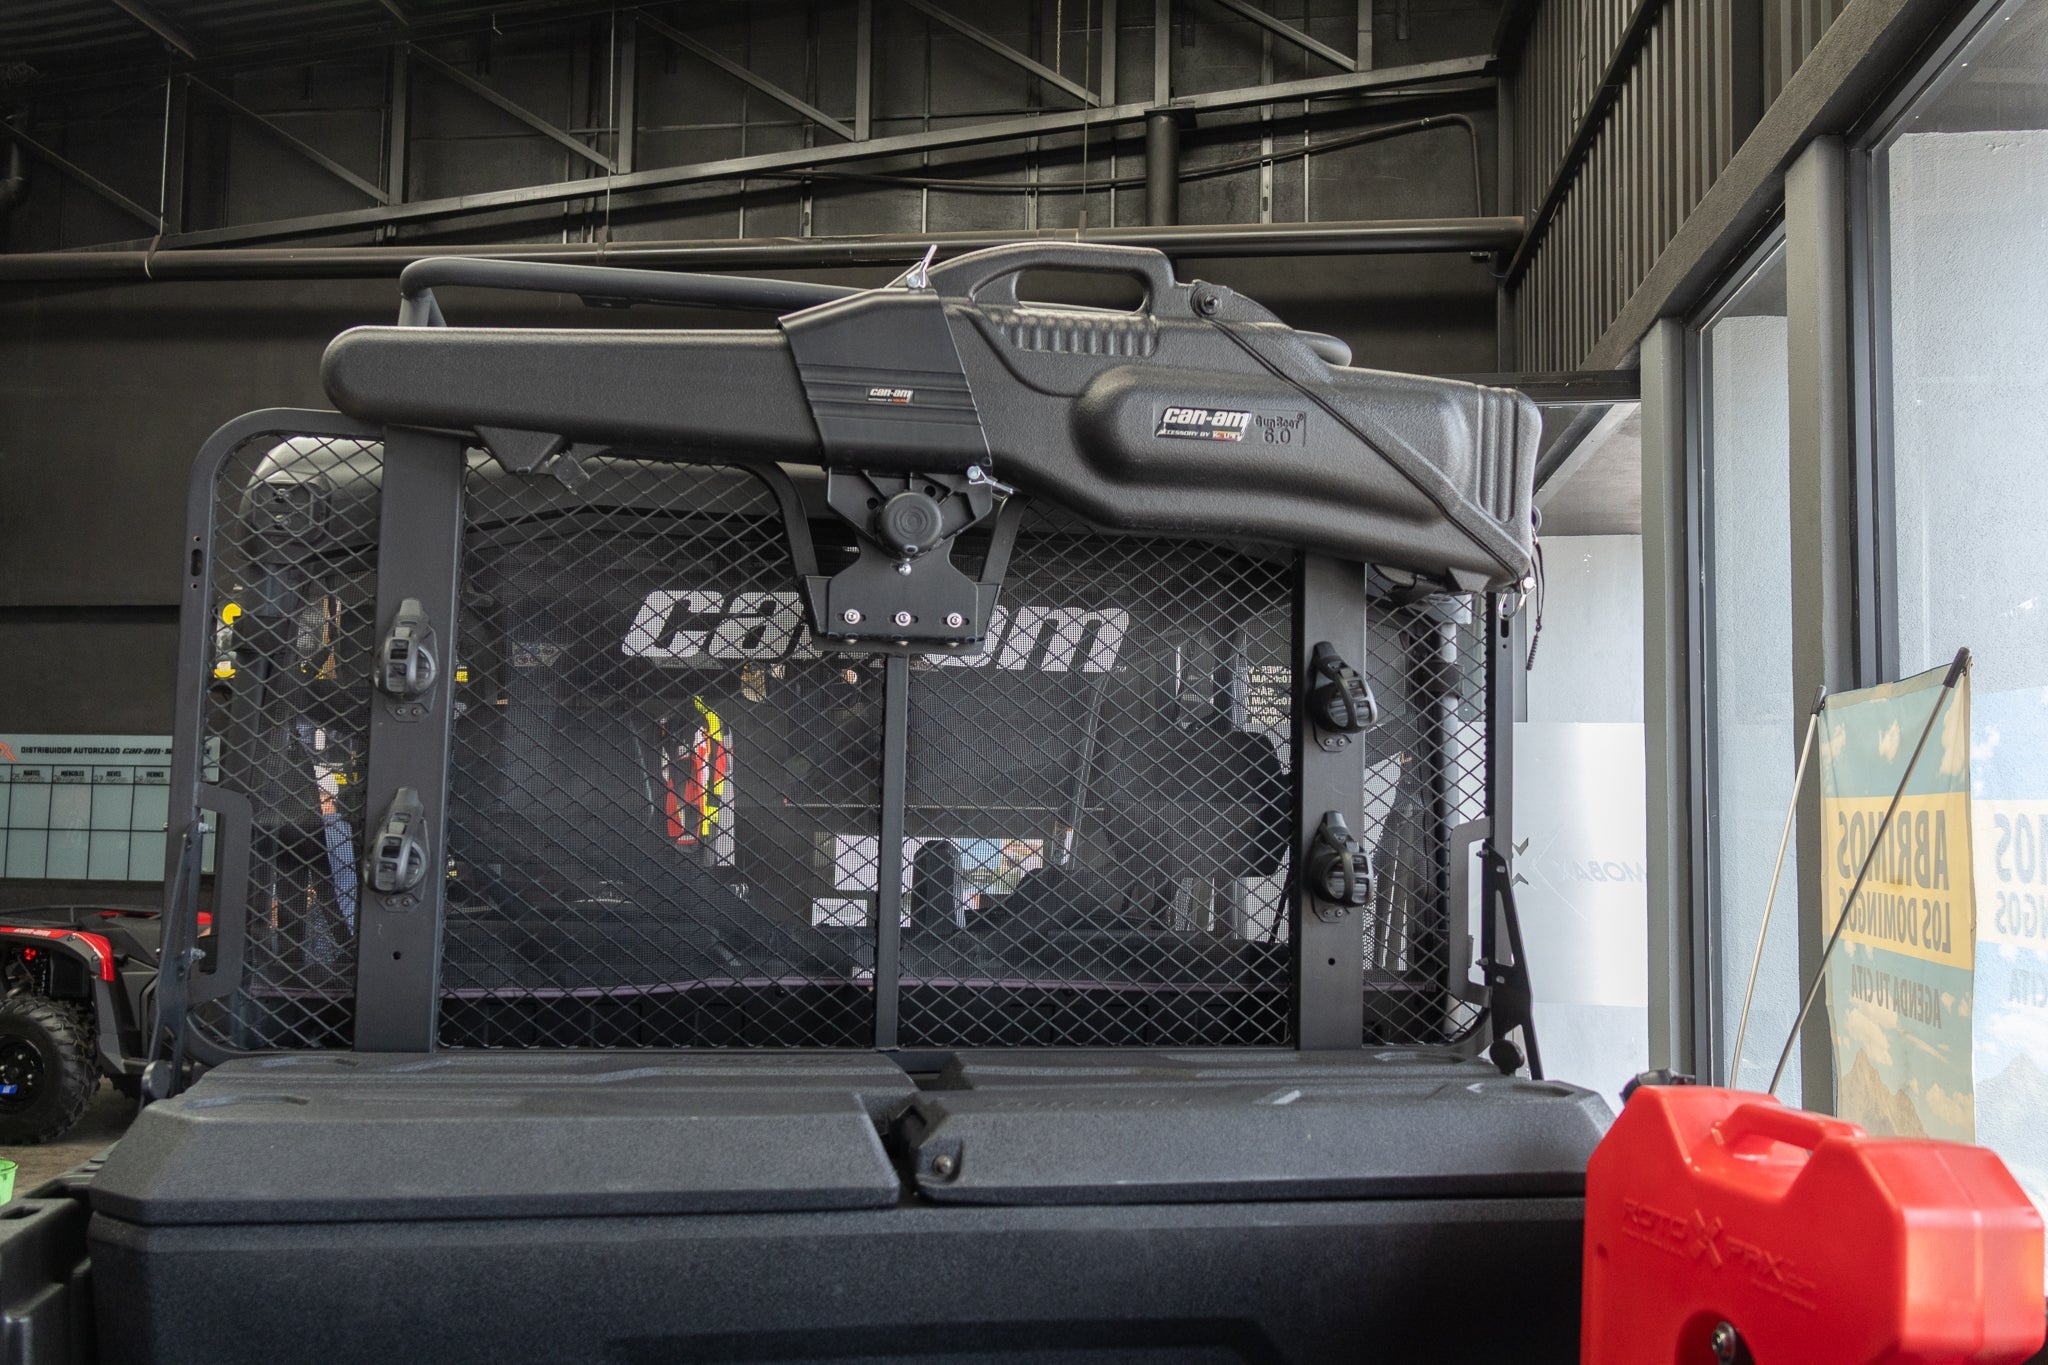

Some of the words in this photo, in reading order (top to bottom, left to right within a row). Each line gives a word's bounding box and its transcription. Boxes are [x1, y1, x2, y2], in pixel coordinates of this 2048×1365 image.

[1164, 407, 1251, 428] can-am
[1264, 428, 1291, 444] 6.0
[21, 746, 72, 754] DISTRIBUIDOR
[122, 747, 160, 755] can-am
